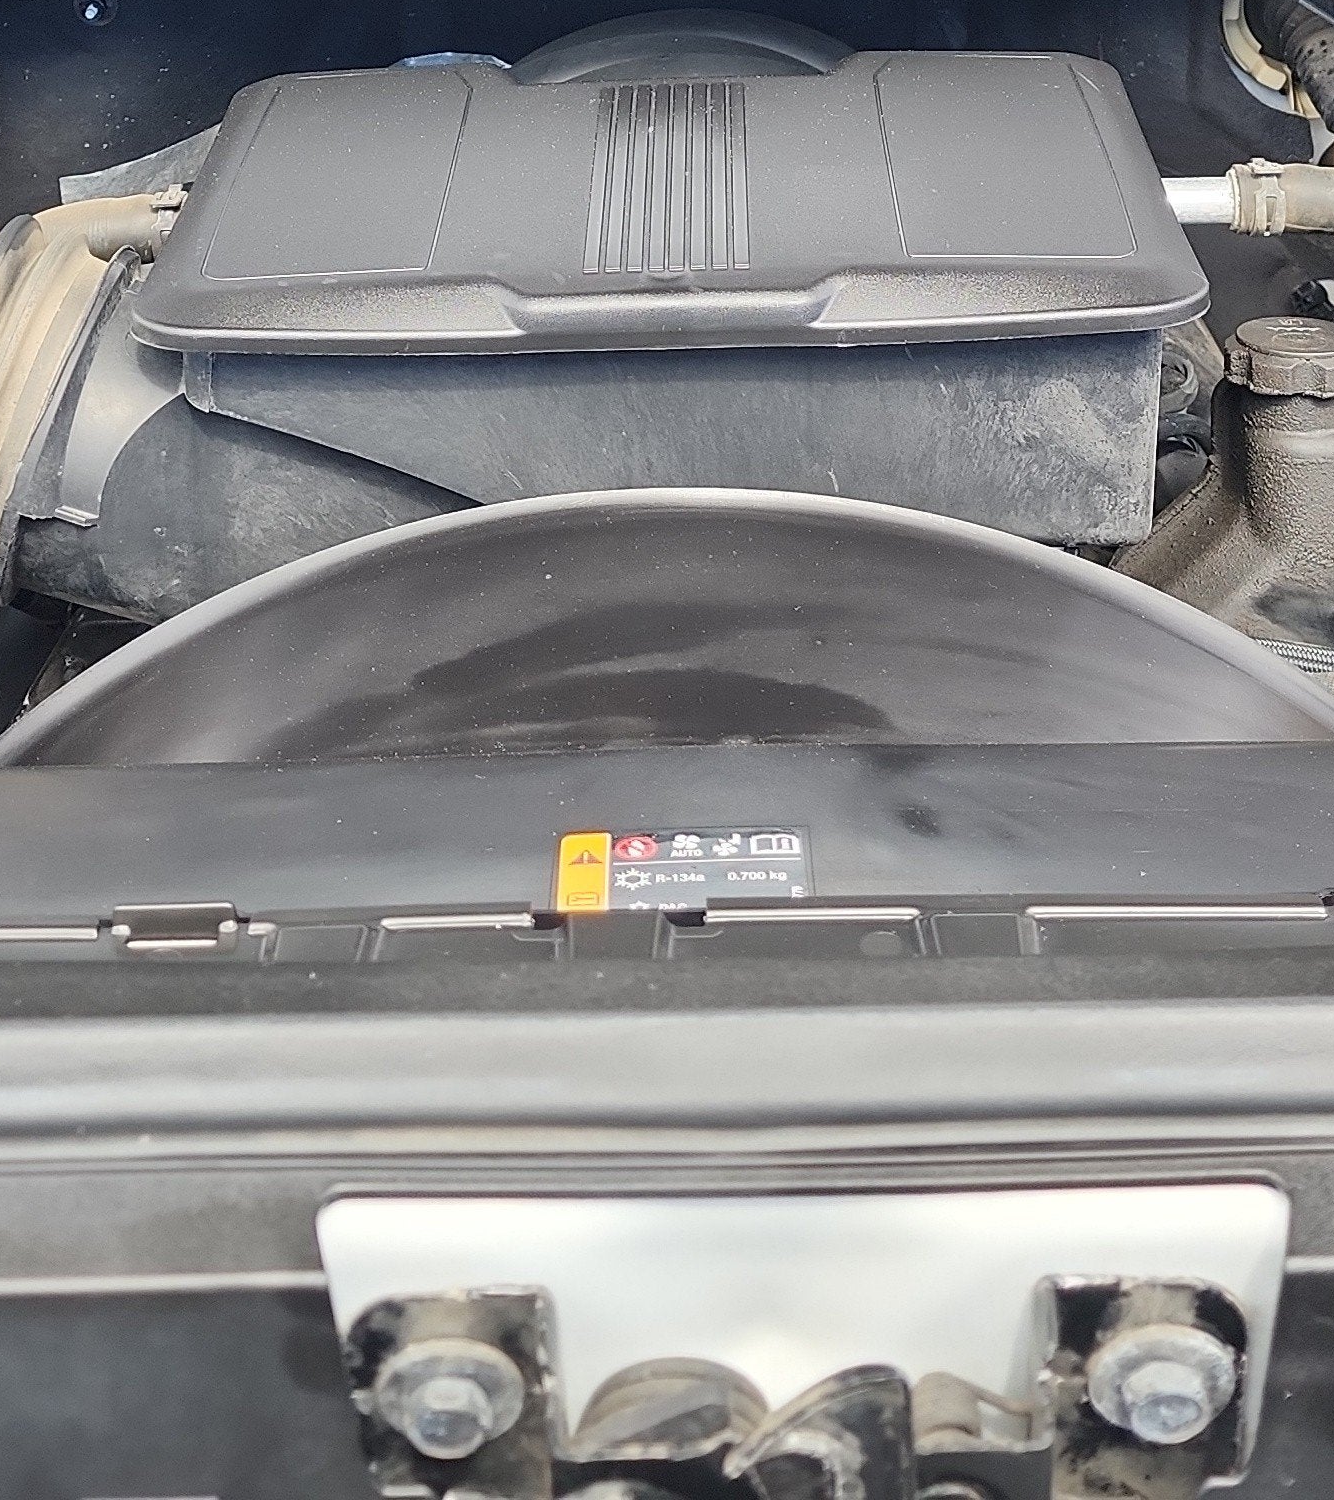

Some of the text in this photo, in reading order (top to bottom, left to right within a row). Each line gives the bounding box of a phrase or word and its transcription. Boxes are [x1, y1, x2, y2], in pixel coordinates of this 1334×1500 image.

[670, 849, 703, 858] AUTO
[655, 870, 788, 883] R-134a 0.700 kg
